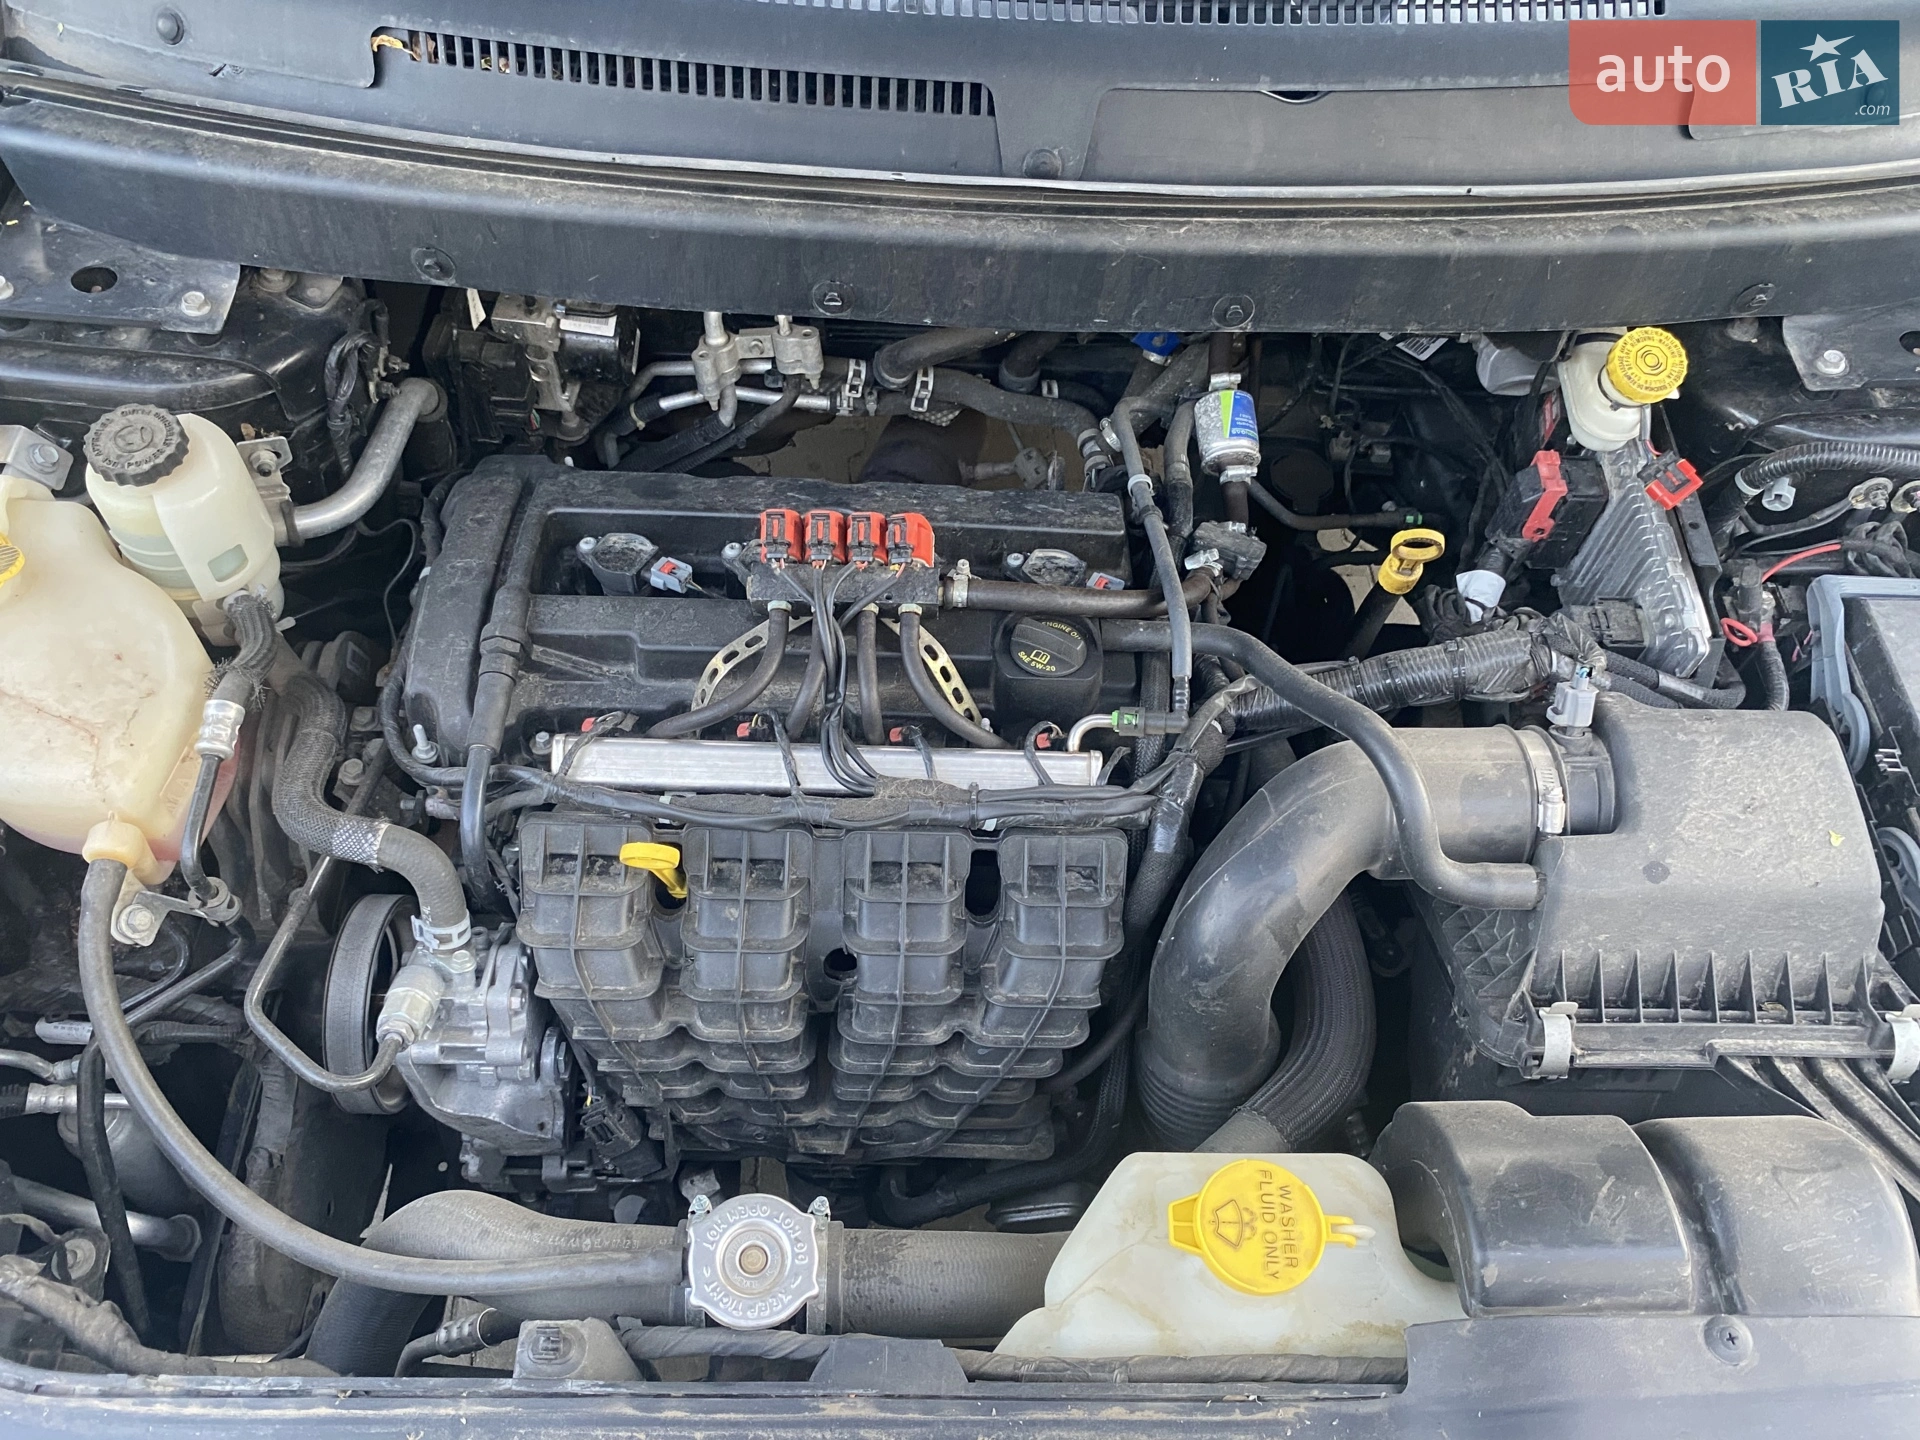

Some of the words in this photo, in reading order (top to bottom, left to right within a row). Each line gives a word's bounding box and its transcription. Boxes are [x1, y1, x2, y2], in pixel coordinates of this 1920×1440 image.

[1625, 349, 1633, 370] BEFORE
[126, 448, 166, 469] POWER
[1018, 651, 1030, 664] SAE
[1031, 661, 1056, 672] 5W-20
[1258, 1170, 1276, 1223] FLUID
[726, 1205, 770, 1221] OPEN
[774, 1212, 800, 1238] NOT
[703, 1220, 728, 1250] HOT
[1279, 1185, 1299, 1268] WASHER
[794, 1242, 809, 1265] DO
[1263, 1230, 1280, 1280] ONLY
